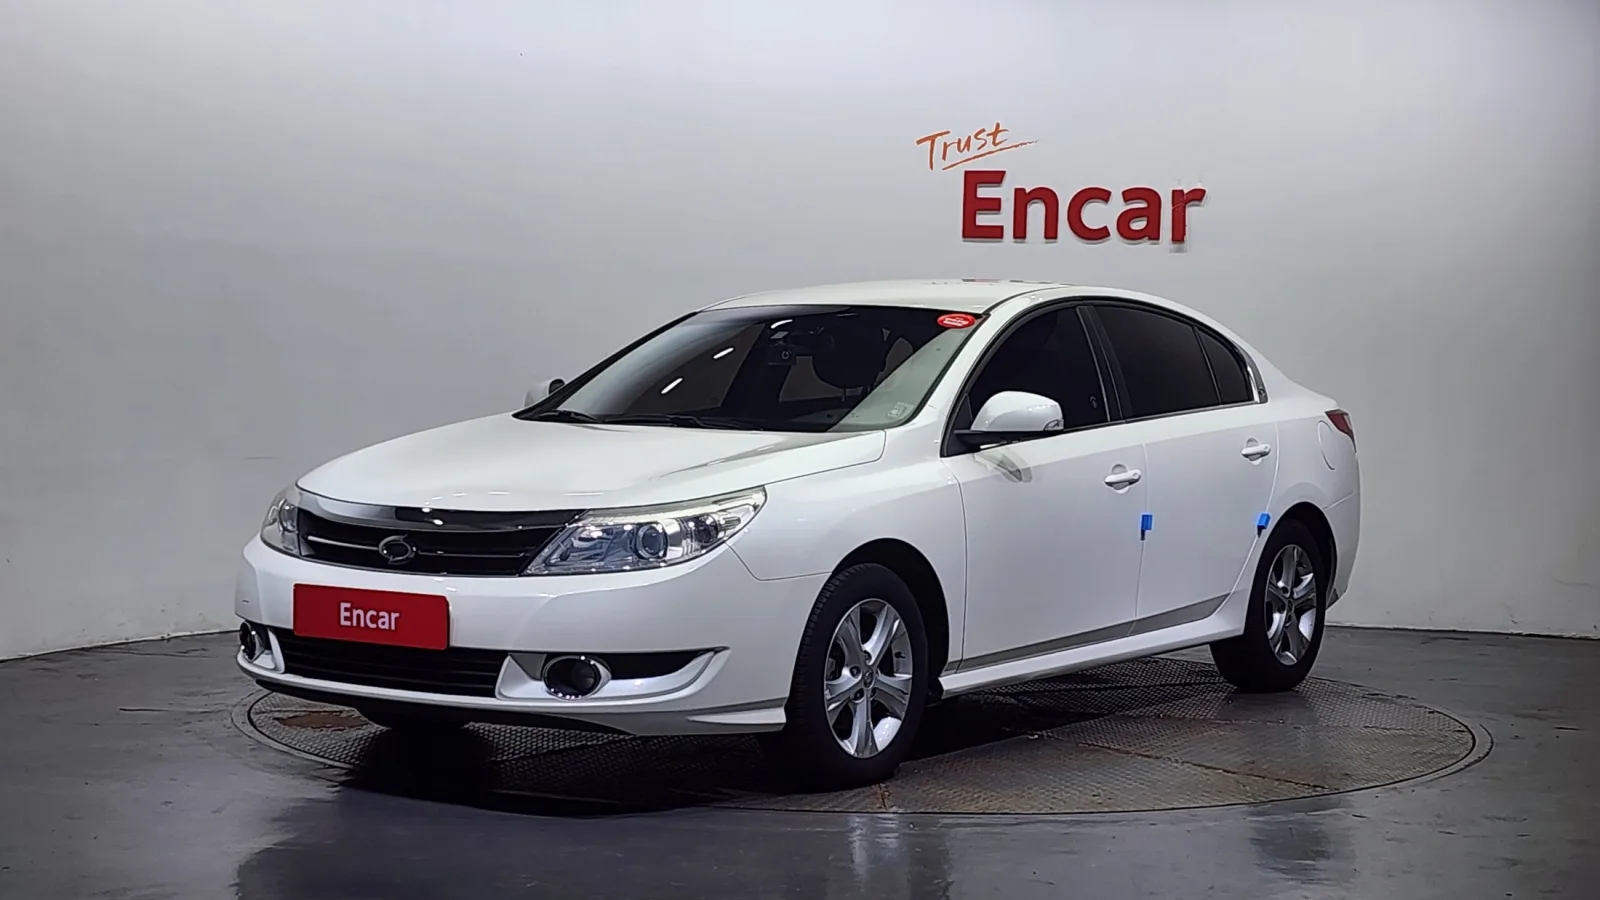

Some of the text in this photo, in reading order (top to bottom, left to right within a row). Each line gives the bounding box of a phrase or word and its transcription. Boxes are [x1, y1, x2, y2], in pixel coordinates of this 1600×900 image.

[916, 122, 1010, 171] Trust
[962, 170, 1207, 243] Encar
[339, 602, 400, 631] Encar
